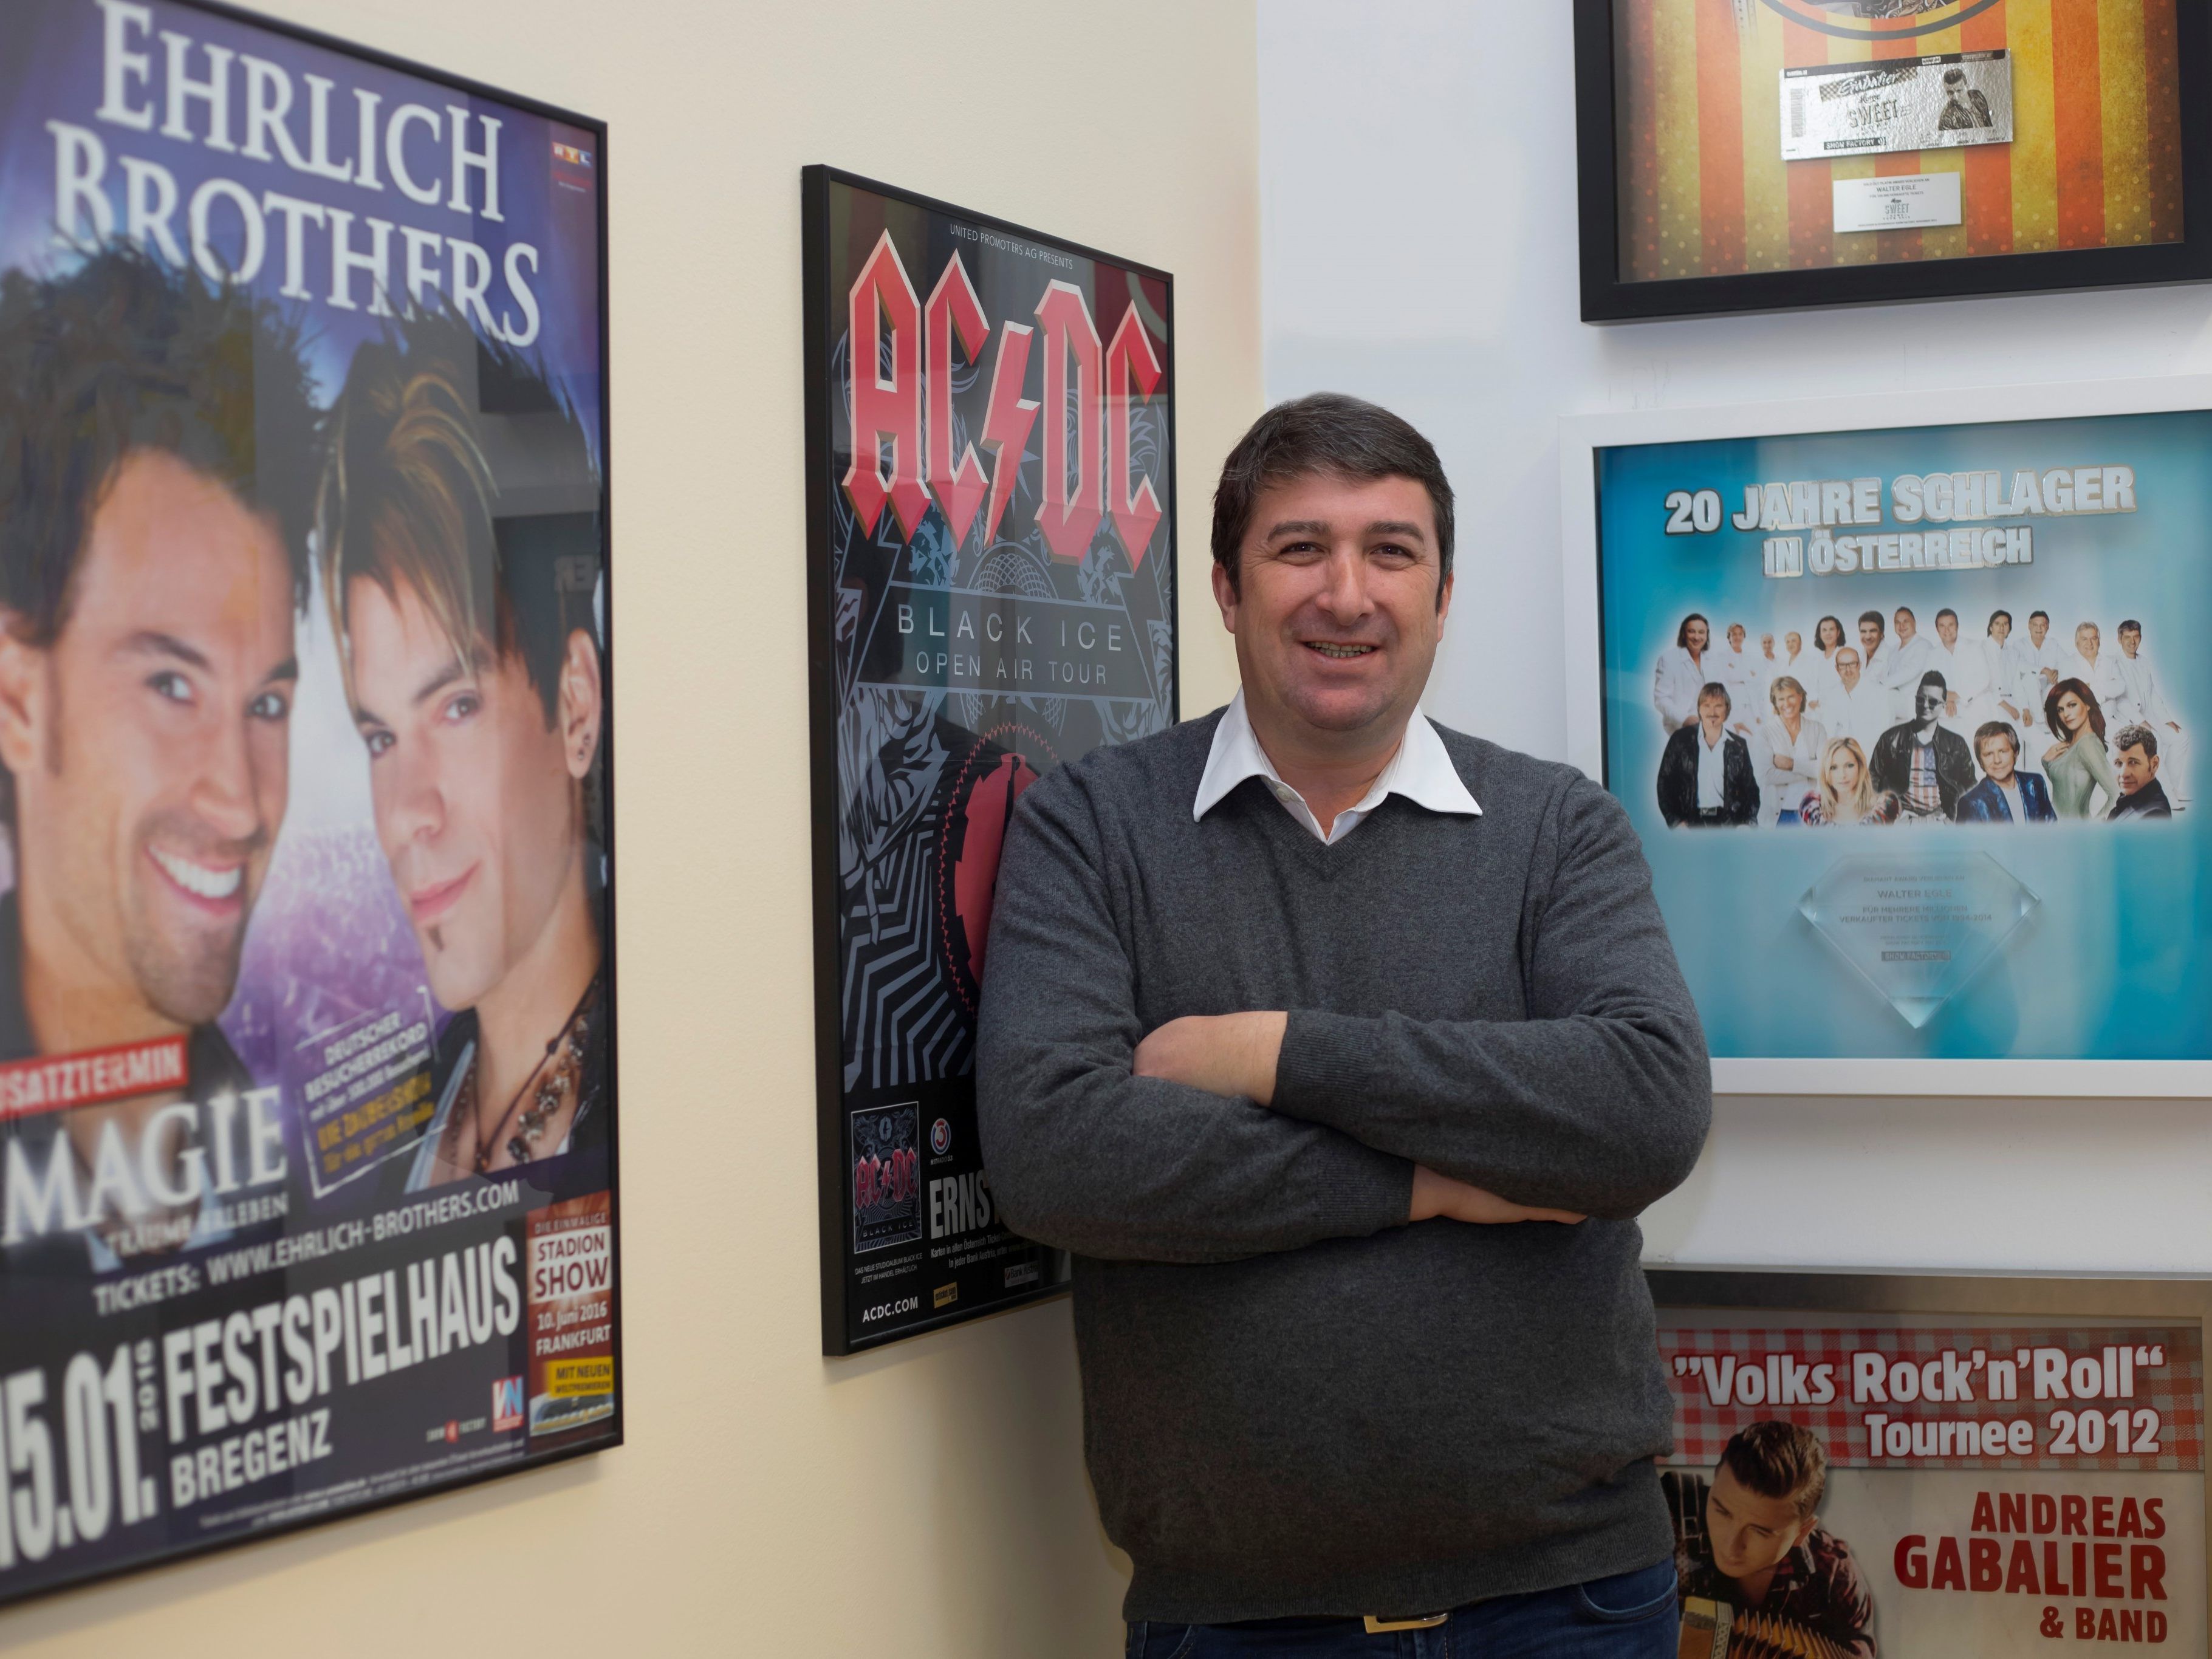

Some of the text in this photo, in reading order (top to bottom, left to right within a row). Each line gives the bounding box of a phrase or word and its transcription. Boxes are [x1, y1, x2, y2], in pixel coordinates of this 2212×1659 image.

[95, 0, 505, 223] EHRLICH
[1846, 98, 1899, 129] SWEET
[1826, 139, 1875, 149] SHOW FACTORY
[1885, 203, 1910, 214] SWEET
[46, 120, 541, 347] BROTHERS
[950, 223, 1073, 270] UNITED PROMOTERS AG PRESENTS
[1666, 466, 2137, 535] 20 JAHRE SCHLAGER
[1763, 526, 2033, 578] IN ÖSTERREICH
[898, 604, 1122, 652] BLACK ICE
[916, 651, 1107, 685] OPEN AIR TOUR
[1862, 905, 1880, 914] FÜR
[1881, 905, 1920, 914] MEHRERE
[1877, 889, 1953, 900] WALTER EGLE
[1839, 915, 1894, 923] VERKAUFTER
[1885, 951, 1937, 960] SHOW FACTORY
[1, 1084, 288, 1246] MAGIE
[930, 1169, 1000, 1240] ERNS
[92, 1179, 520, 1316] TICKETS: WWW.EHRLICH-BROTHERS.COM
[538, 1233, 604, 1262] STADION
[863, 1225, 892, 1237] BLACK
[931, 1247, 946, 1258] Karten
[946, 1245, 951, 1254] in
[951, 1242, 963, 1253] allen
[964, 1237, 986, 1250] Österreich
[535, 1257, 608, 1298] SHOW
[861, 1275, 873, 1284] JETZT
[878, 1270, 895, 1279] HANDEL
[875, 1258, 903, 1270] STUDIOALBUM
[948, 1259, 954, 1268] In
[954, 1256, 966, 1269] jeder
[967, 1252, 979, 1264] Bank
[556, 1307, 579, 1332] Juni
[580, 1301, 608, 1322] 2016
[862, 1296, 919, 1323] ACDC.COM
[164, 1235, 521, 1445] FESTSPIELHAUS
[535, 1324, 612, 1356] FRANKFURT
[1864, 1408, 2161, 1457] Tournee 2012
[171, 1408, 332, 1509] BREGENZ
[1971, 1490, 2166, 1541] ANDREAS
[1894, 1533, 2169, 1600] GABALIER
[2039, 1606, 2168, 1644] & BAND
